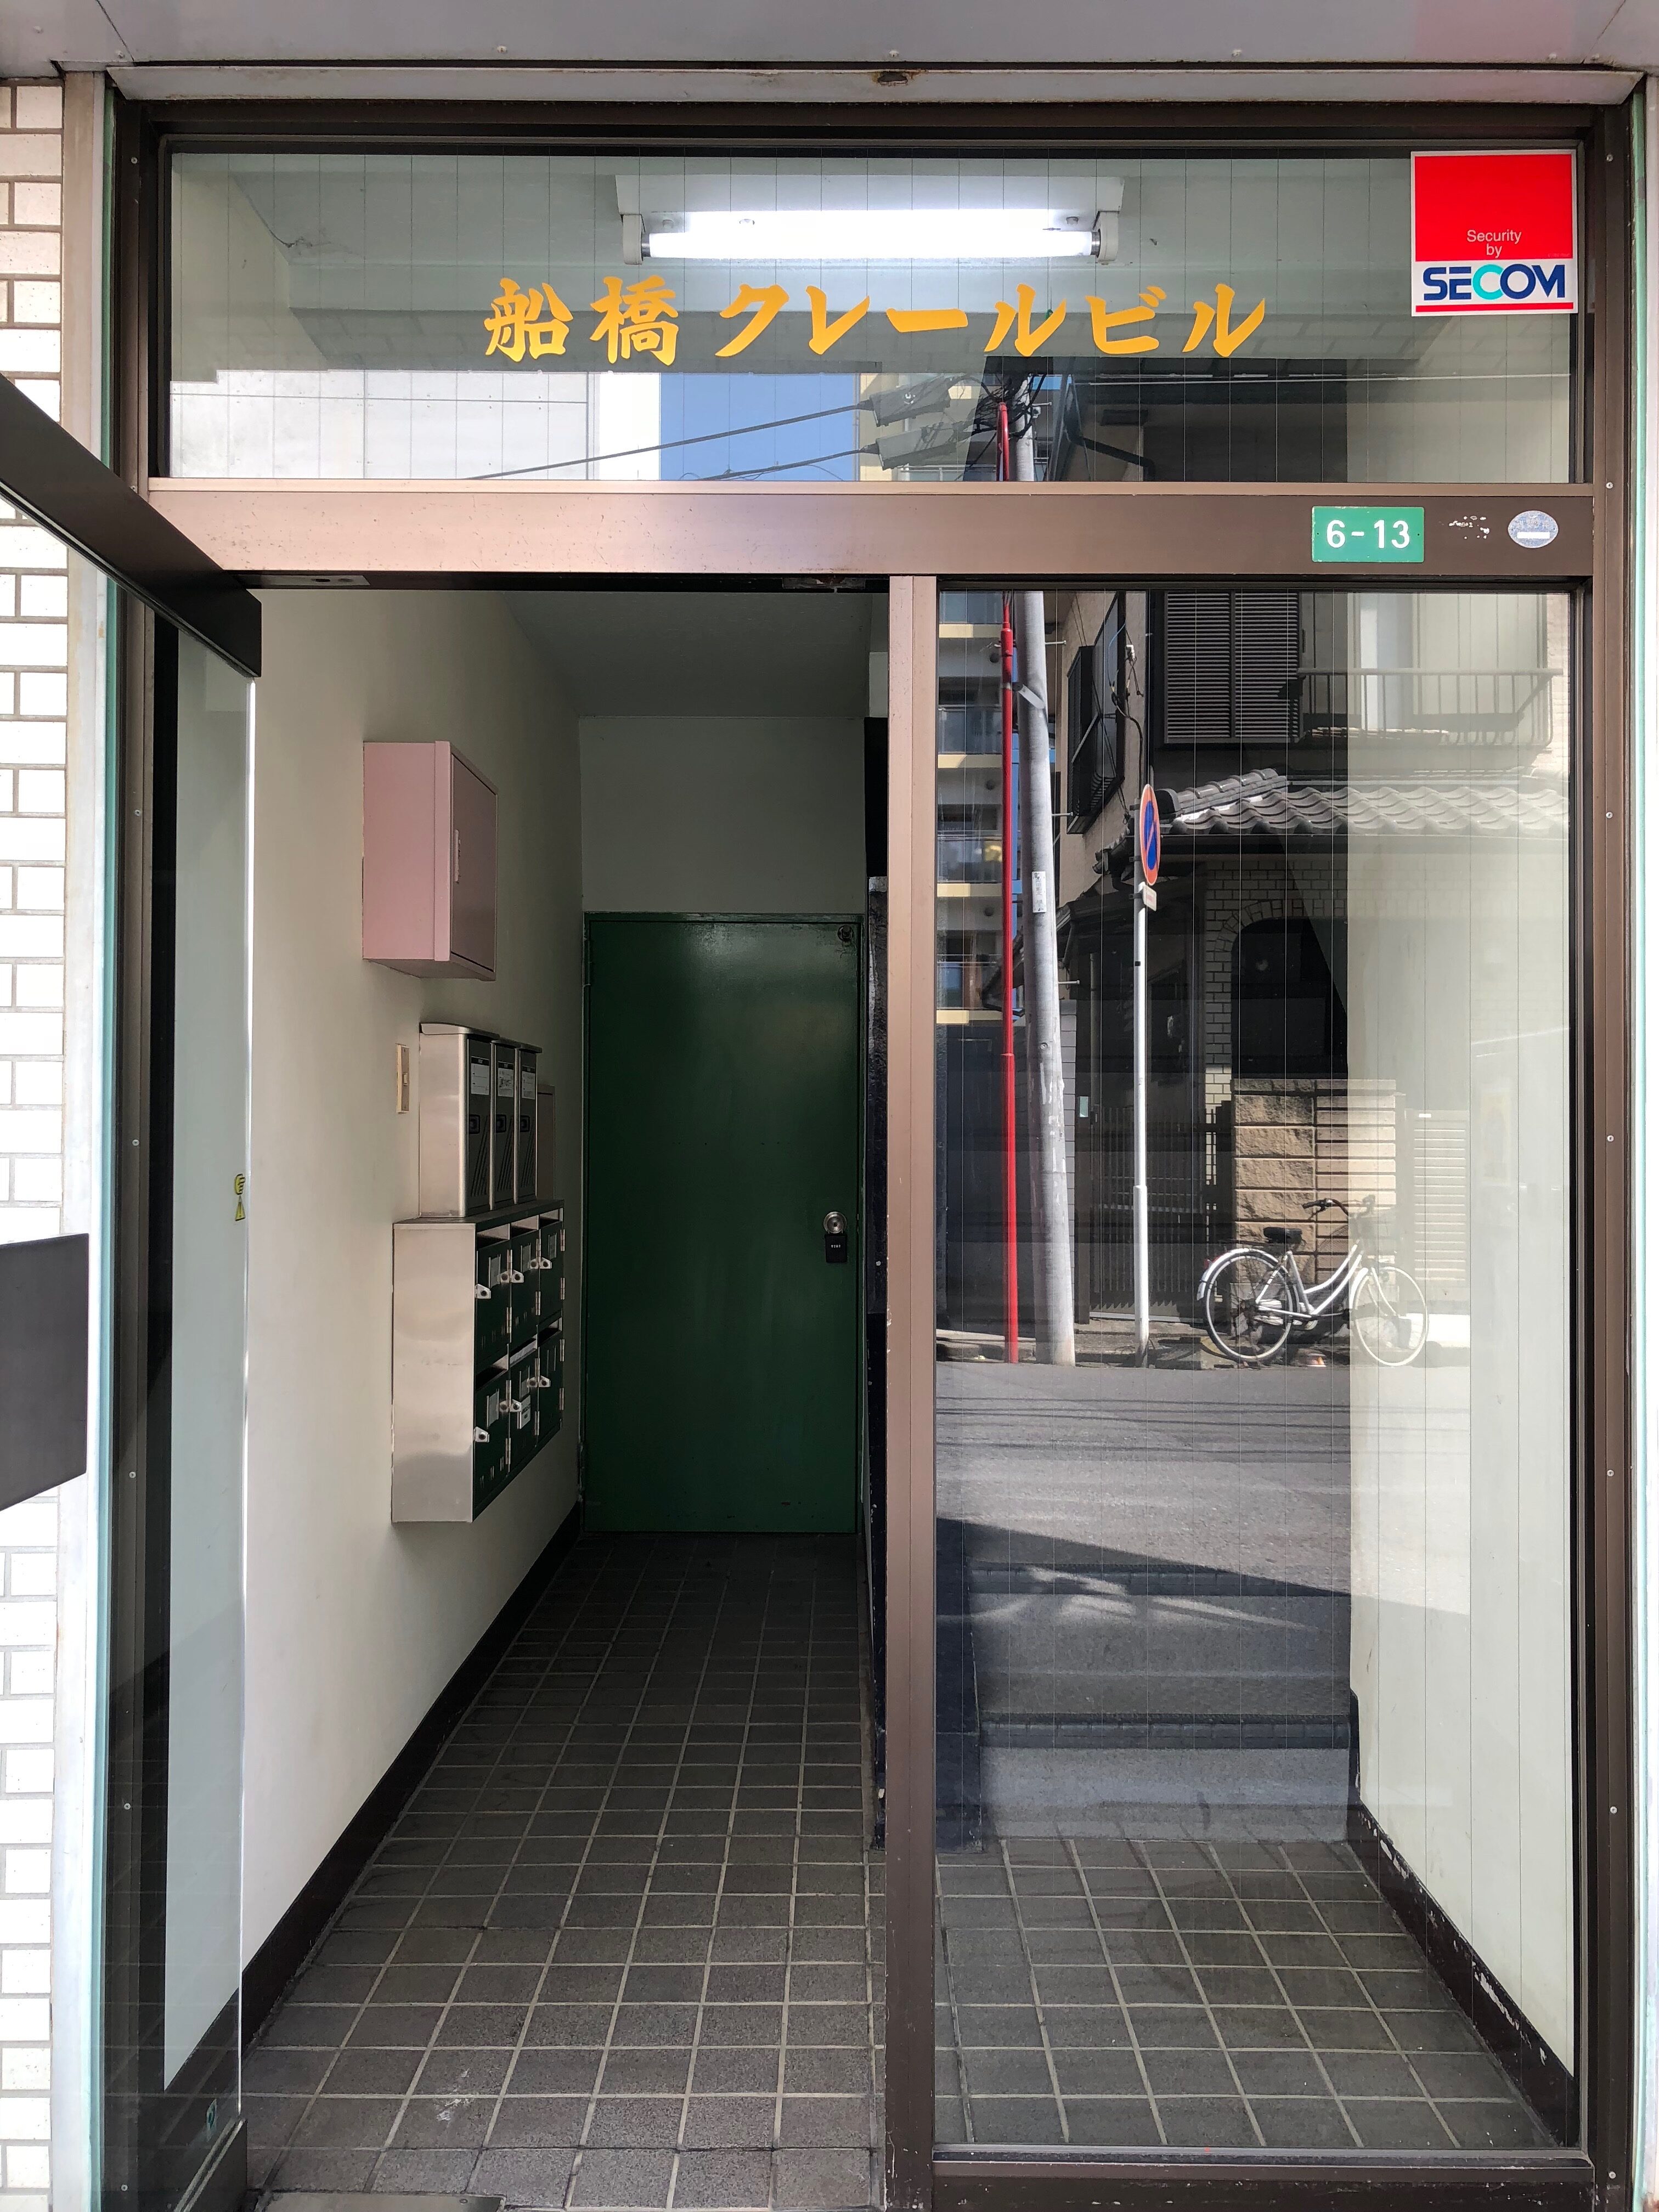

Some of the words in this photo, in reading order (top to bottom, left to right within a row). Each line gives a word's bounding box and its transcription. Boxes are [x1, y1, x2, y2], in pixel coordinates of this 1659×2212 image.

[1466, 229, 1522, 245] Security
[1486, 243, 1503, 258] by
[1423, 263, 1566, 301] SECOM
[1326, 519, 1410, 549] 6-13
